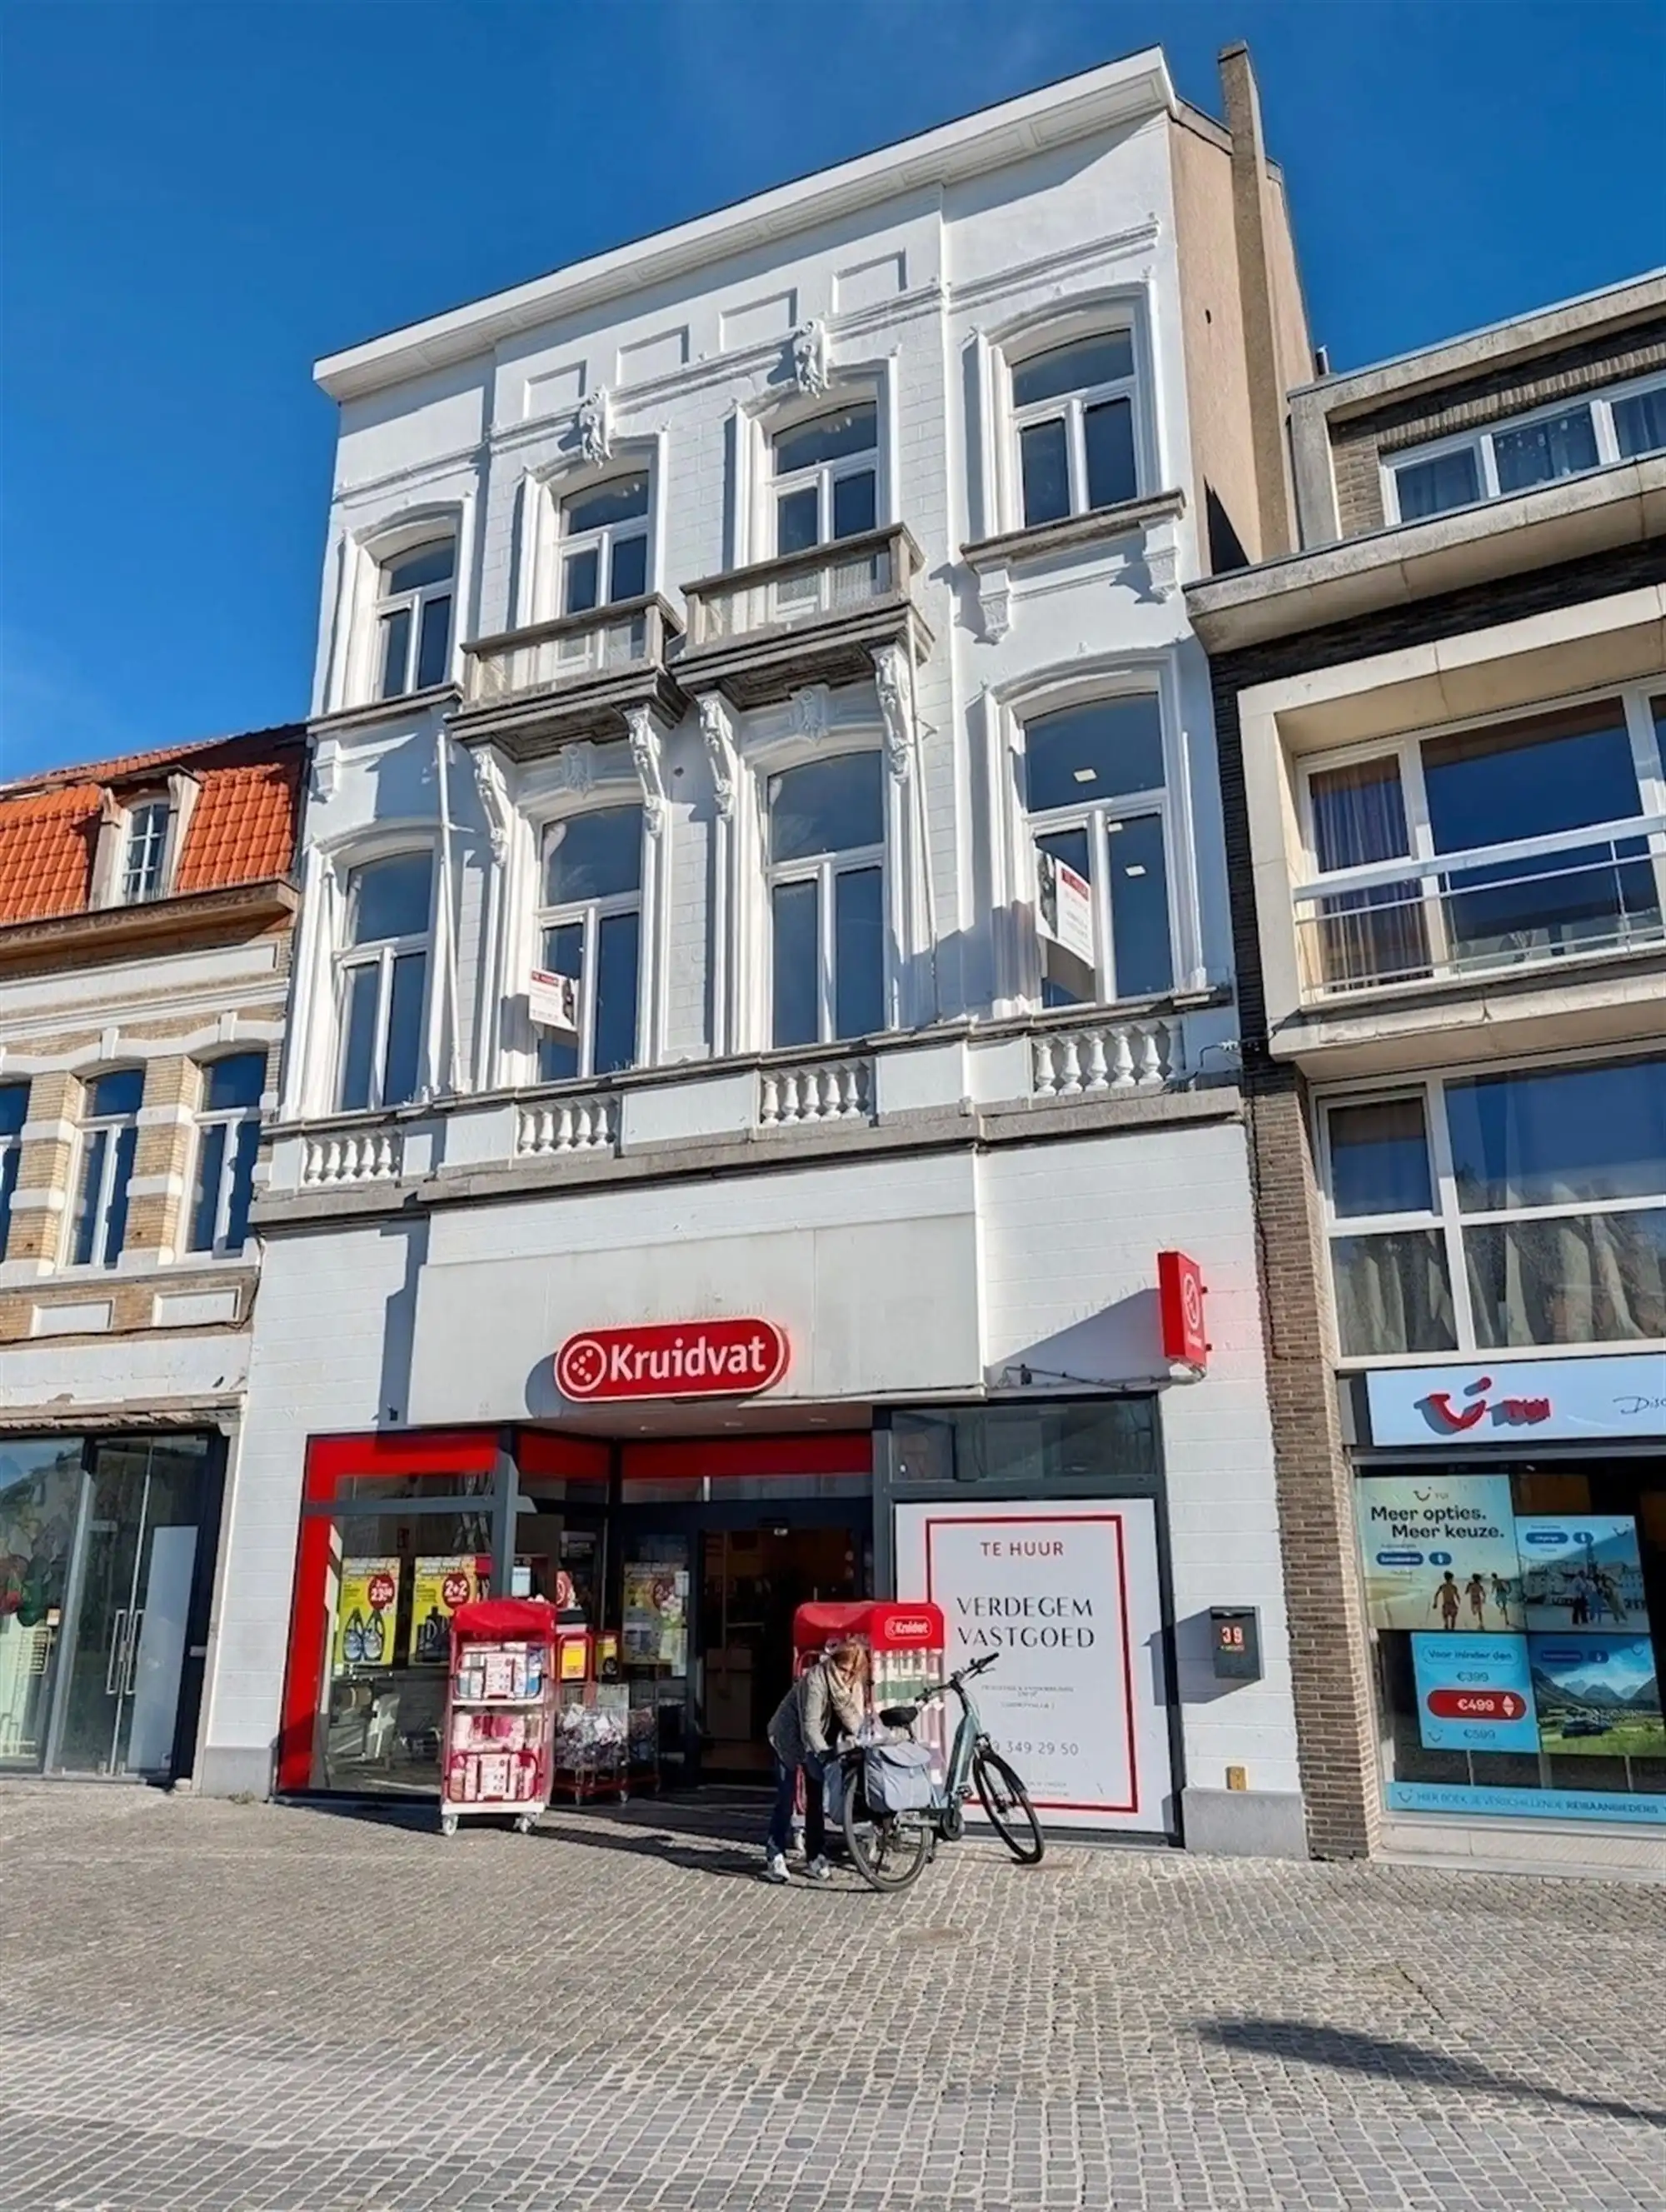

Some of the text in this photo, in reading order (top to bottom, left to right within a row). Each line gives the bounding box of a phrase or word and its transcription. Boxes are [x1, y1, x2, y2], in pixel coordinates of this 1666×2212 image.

[610, 1336, 766, 1381] Kruidvat
[1371, 1505, 1487, 1524] Meer opties.
[1392, 1524, 1504, 1539] Meer keuze.
[980, 1541, 1064, 1556] TE HUUR
[957, 1596, 1093, 1617] VERDEGEM
[957, 1626, 1095, 1648] VASTGOED
[1456, 1670, 1489, 1682] €399
[1456, 1698, 1495, 1711] €499
[1006, 1740, 1032, 1754] 349
[1038, 1741, 1055, 1755] 29
[1060, 1743, 1079, 1755] 50
